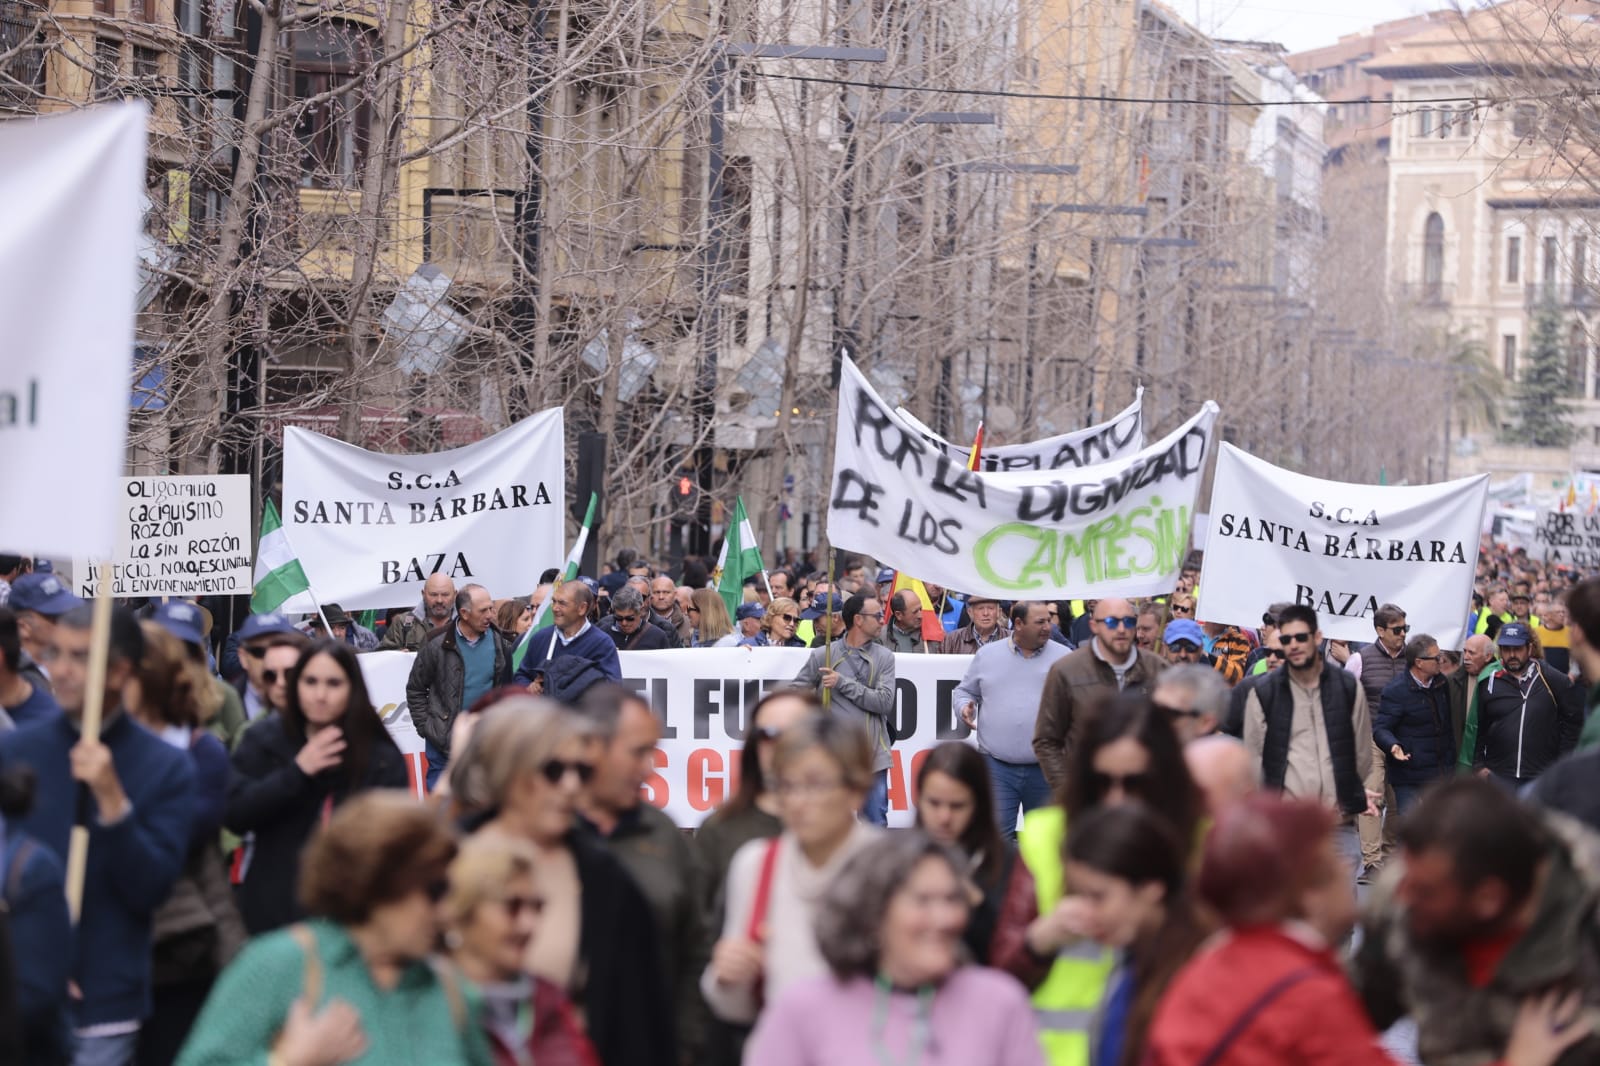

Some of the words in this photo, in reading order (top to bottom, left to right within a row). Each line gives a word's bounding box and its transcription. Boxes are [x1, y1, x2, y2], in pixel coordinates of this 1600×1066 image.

[855, 386, 927, 477] POR
[930, 453, 987, 509] LA
[387, 469, 463, 490] S.C.A
[293, 500, 396, 525] SANTA
[408, 481, 552, 525] BÁRBARA
[832, 468, 886, 528] DE
[898, 498, 964, 555] LOS
[1309, 500, 1380, 526] S.C.A
[1546, 511, 1574, 531] POR
[1219, 513, 1311, 553] SANTA
[1322, 531, 1467, 564] BÁRBARA
[380, 551, 475, 584] BAZA
[1295, 584, 1379, 618] BAZA
